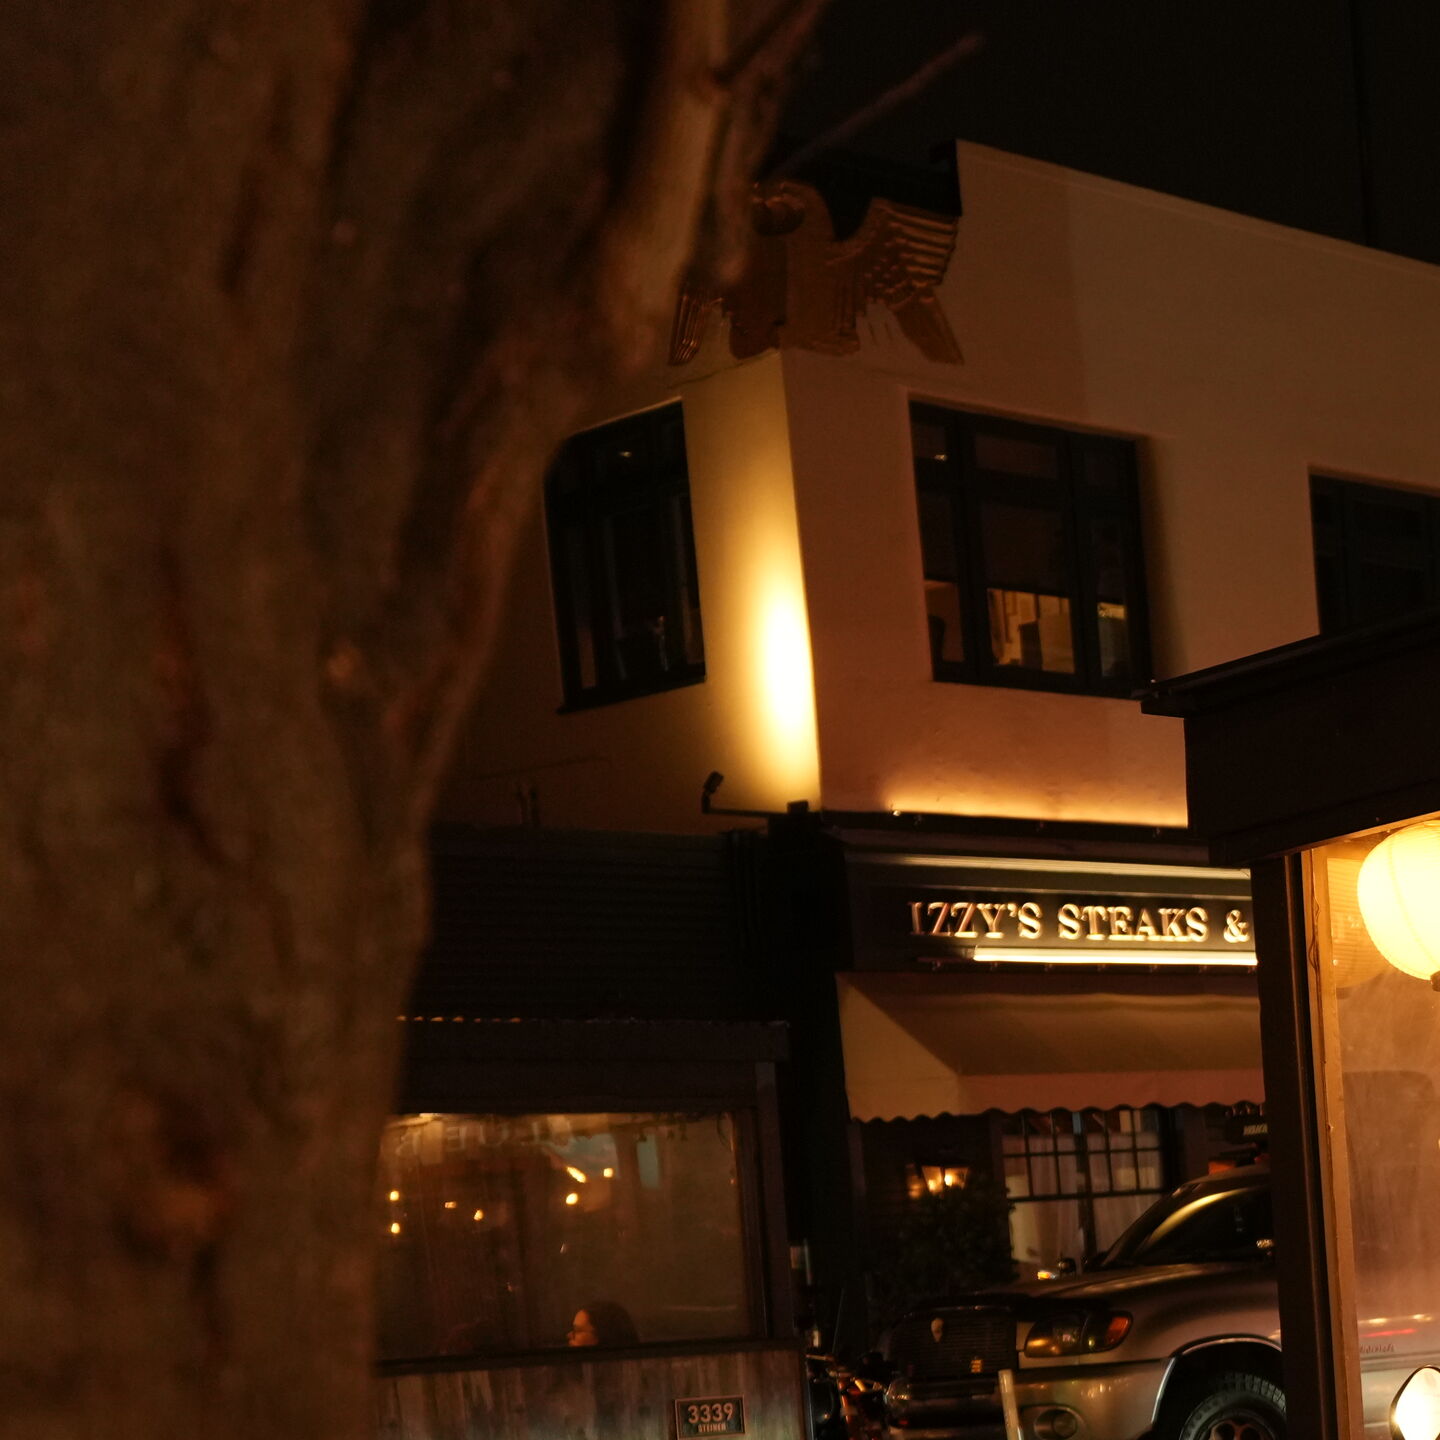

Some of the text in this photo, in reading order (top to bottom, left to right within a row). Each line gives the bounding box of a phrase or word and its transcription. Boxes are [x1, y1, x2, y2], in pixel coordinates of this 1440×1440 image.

[910, 902, 1249, 943] IZZY'S STEAKS &
[688, 1403, 734, 1424] 3339
